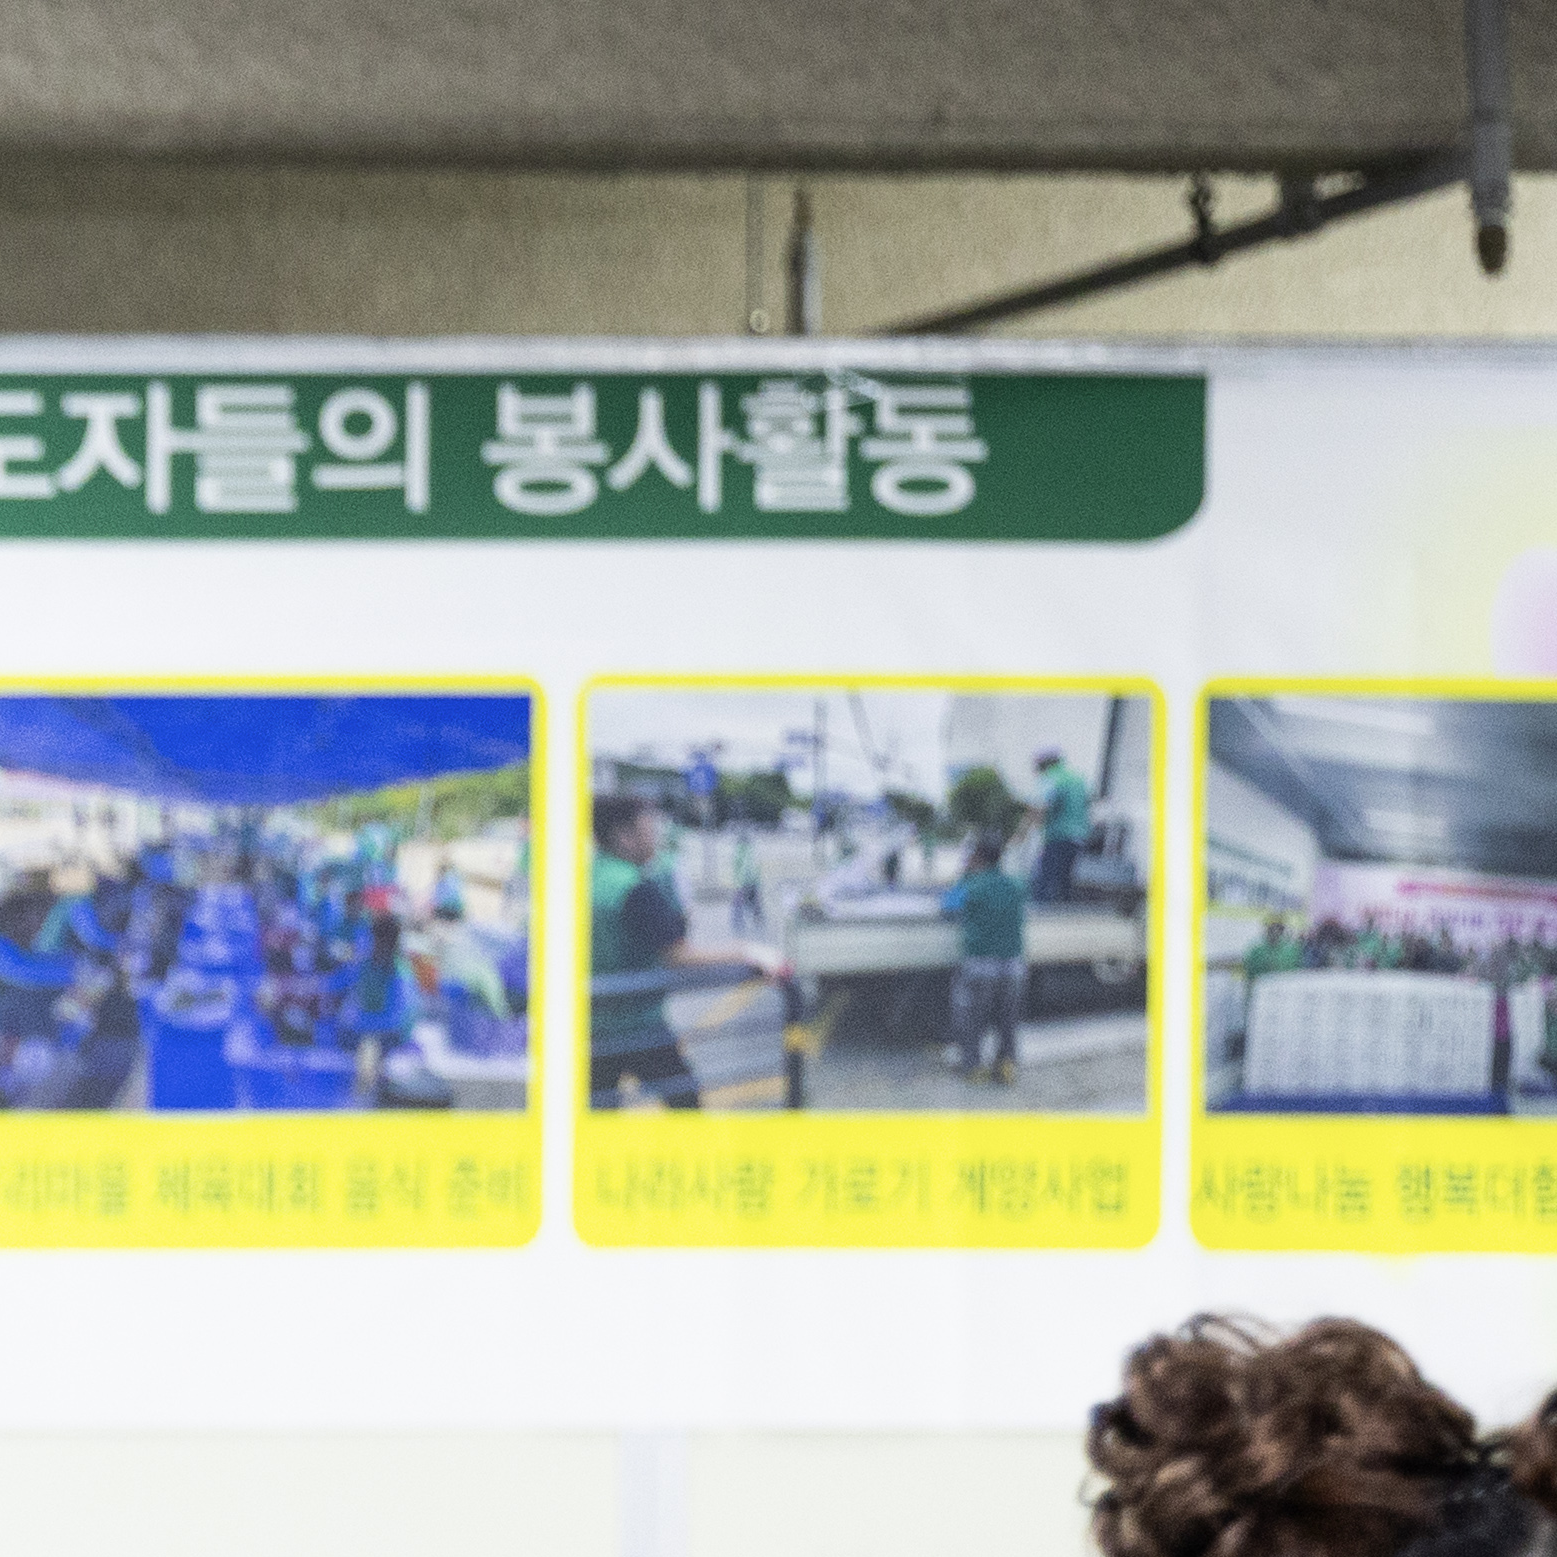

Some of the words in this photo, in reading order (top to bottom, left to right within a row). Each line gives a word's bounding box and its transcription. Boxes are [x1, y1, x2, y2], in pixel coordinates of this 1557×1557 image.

[482, 380, 988, 515] 봉사활동
[594, 1154, 778, 1220] 나라사랑
[1191, 1157, 1373, 1221] 사랑나눔
